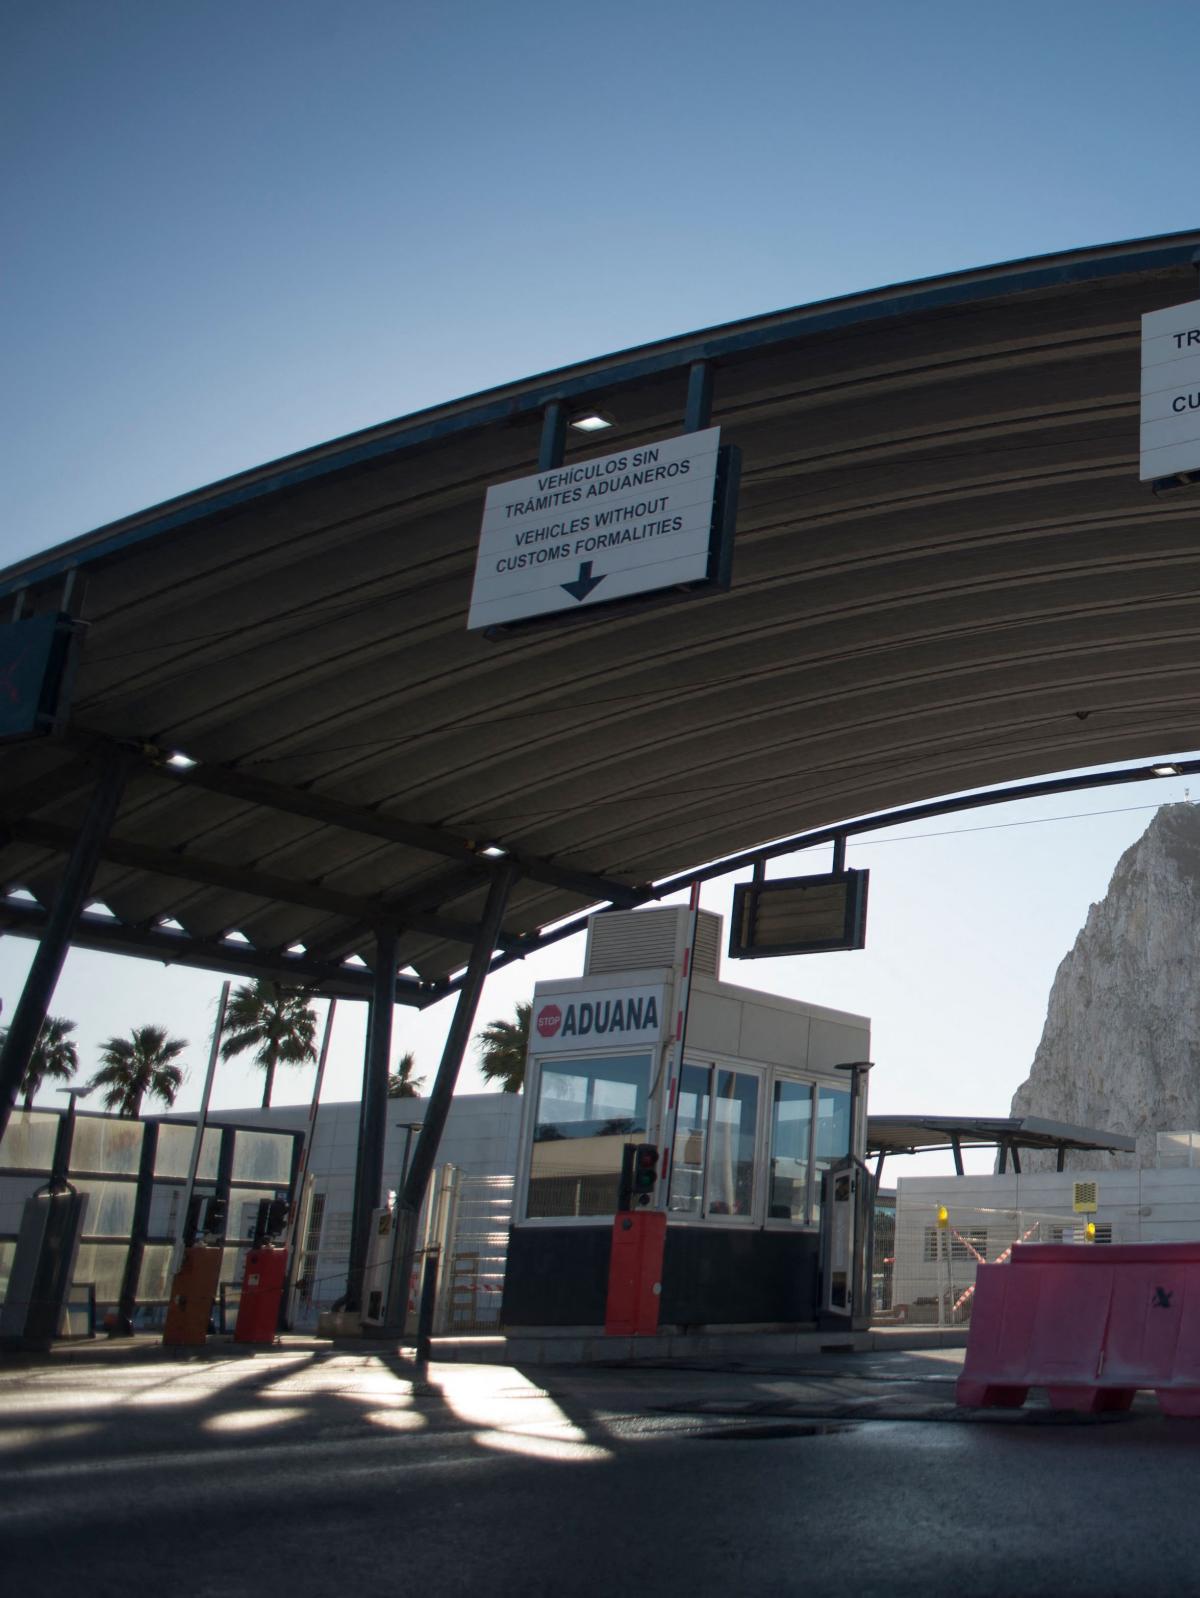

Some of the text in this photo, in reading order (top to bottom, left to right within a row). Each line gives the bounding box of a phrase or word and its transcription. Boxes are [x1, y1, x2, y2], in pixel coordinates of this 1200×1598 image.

[505, 459, 691, 518] TRÁMITES ADUANEROS
[538, 448, 659, 491] VEHÍCULOS SIN
[496, 516, 683, 573] CUSTOMS FORMALITIES
[515, 496, 669, 546] VEHICLES WITHOUT
[538, 995, 659, 1037] STOP ADUANA
